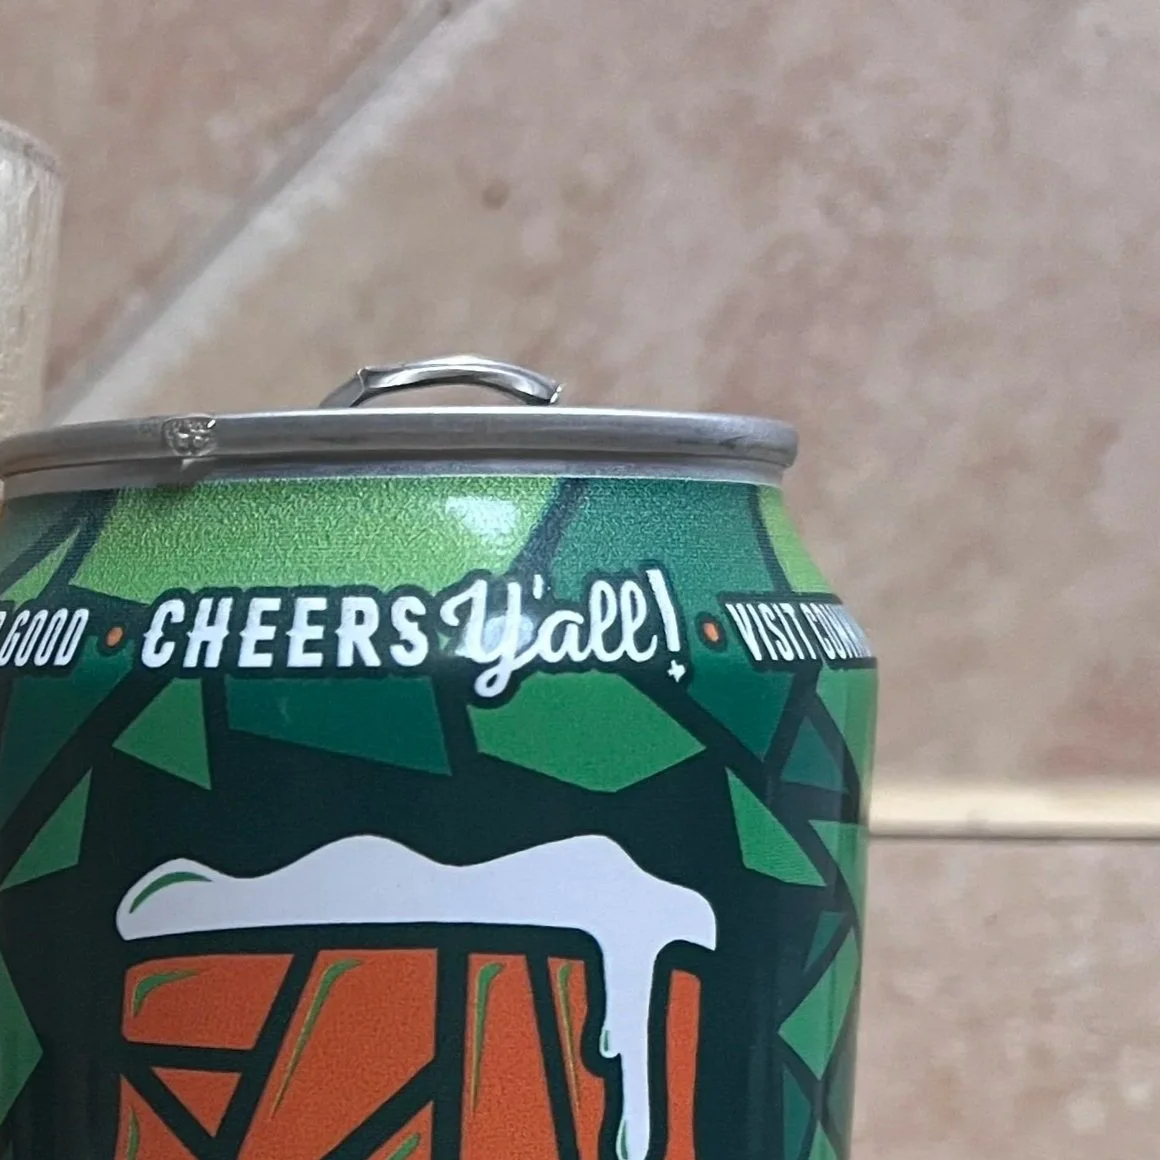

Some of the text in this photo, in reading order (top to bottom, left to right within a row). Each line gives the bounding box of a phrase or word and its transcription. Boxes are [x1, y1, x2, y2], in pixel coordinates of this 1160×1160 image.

[140, 567, 687, 698] CHEERS Y'all!
[724, 602, 818, 661] VISIT
